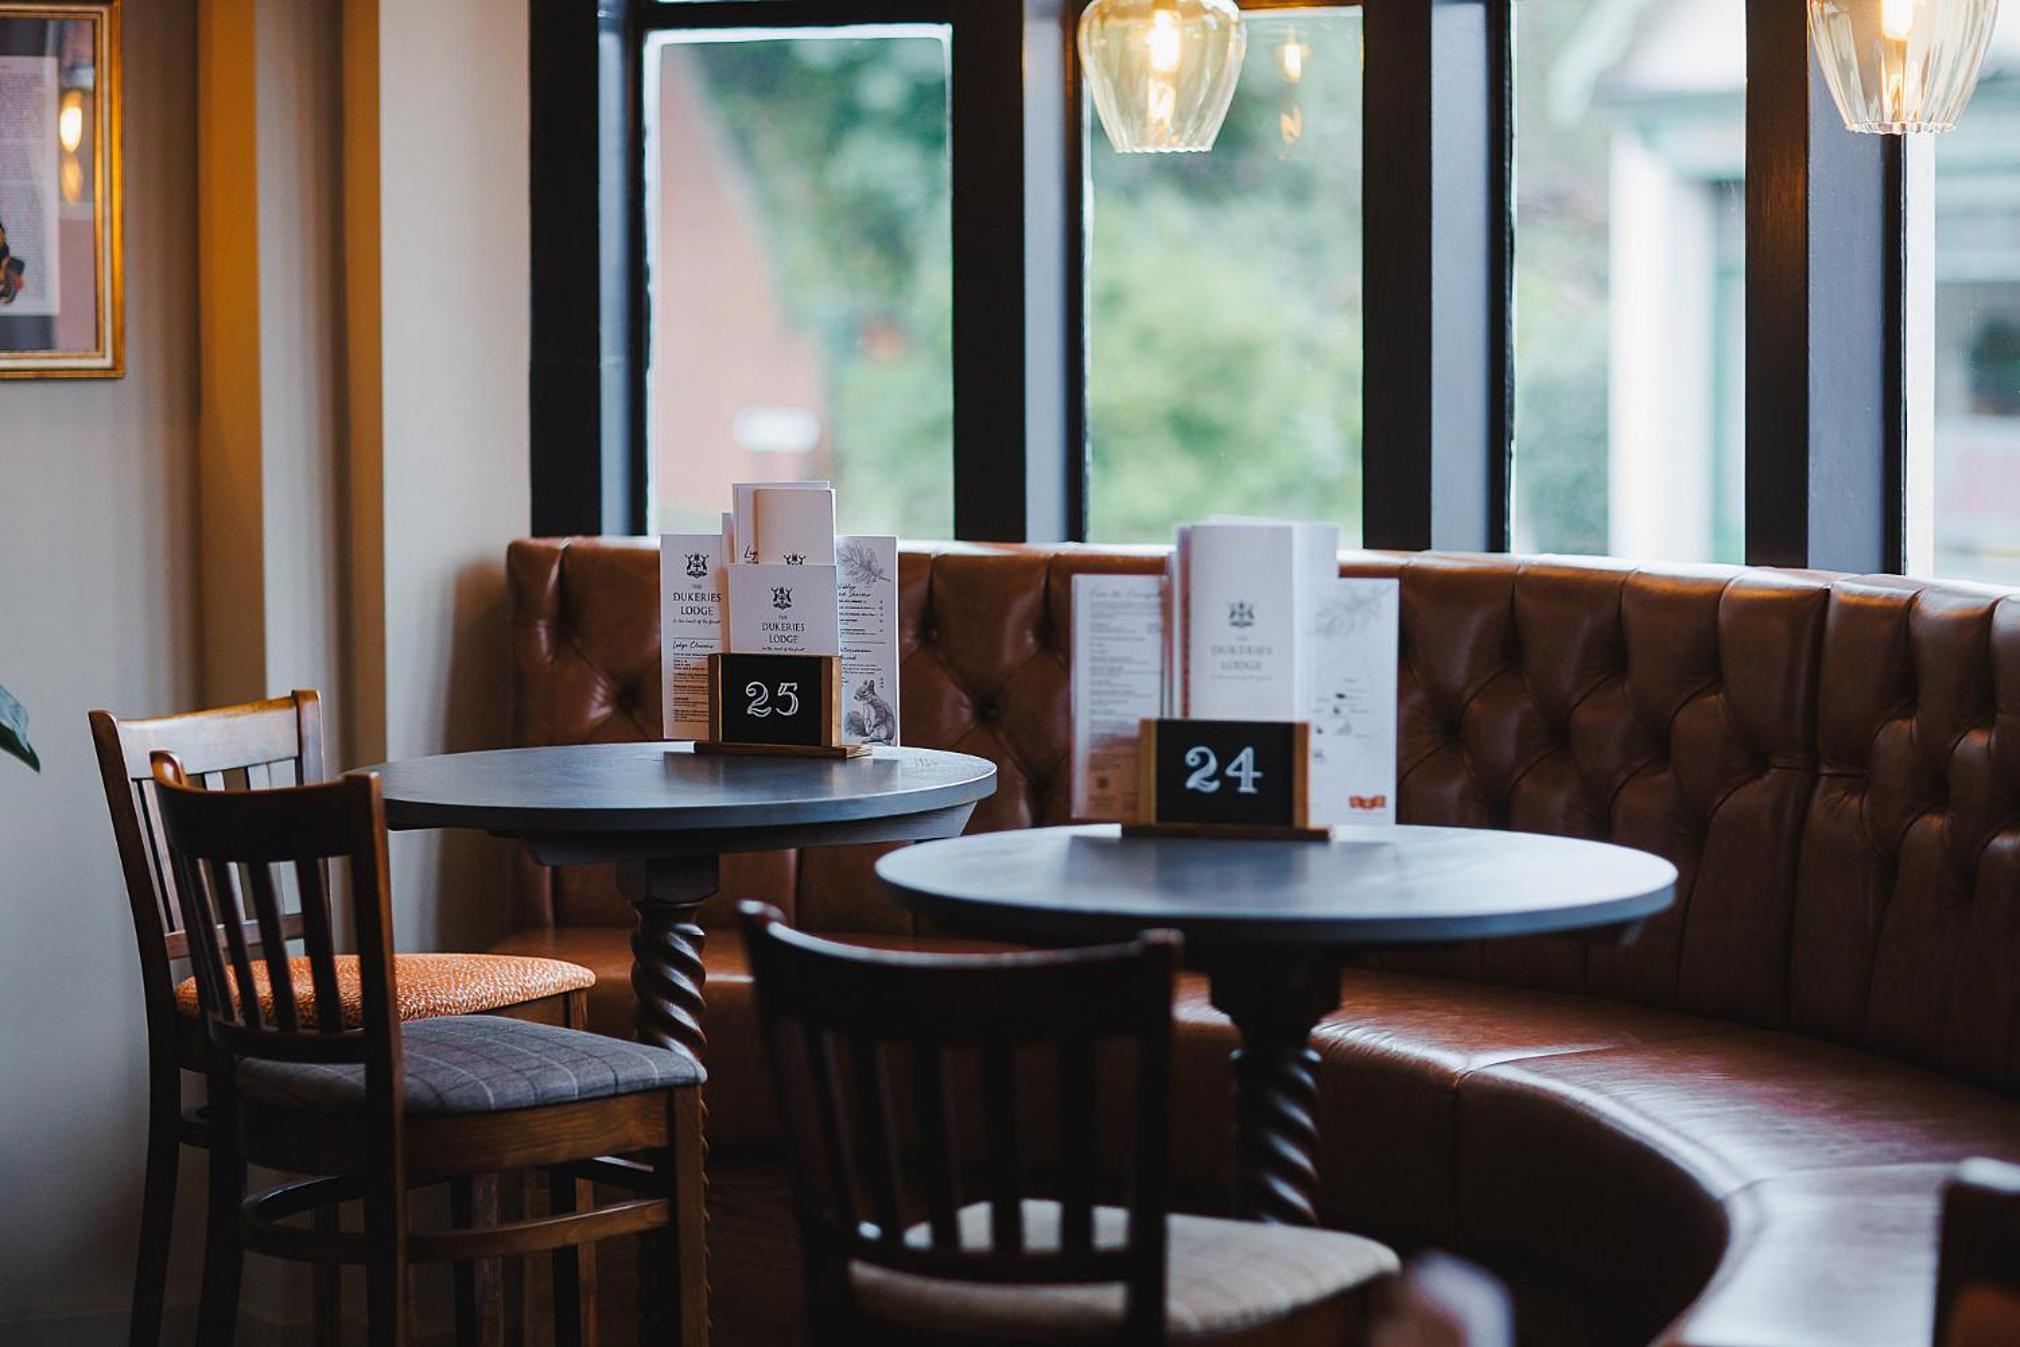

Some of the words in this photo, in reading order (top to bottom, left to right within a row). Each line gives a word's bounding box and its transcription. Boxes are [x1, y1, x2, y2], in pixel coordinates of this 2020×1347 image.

[673, 592, 722, 602] DUKERIES
[680, 605, 715, 616] LODGE
[761, 622, 805, 632] DUKERIES
[769, 634, 799, 644] LODGE
[745, 681, 799, 718] 25
[1184, 745, 1264, 794] 24
